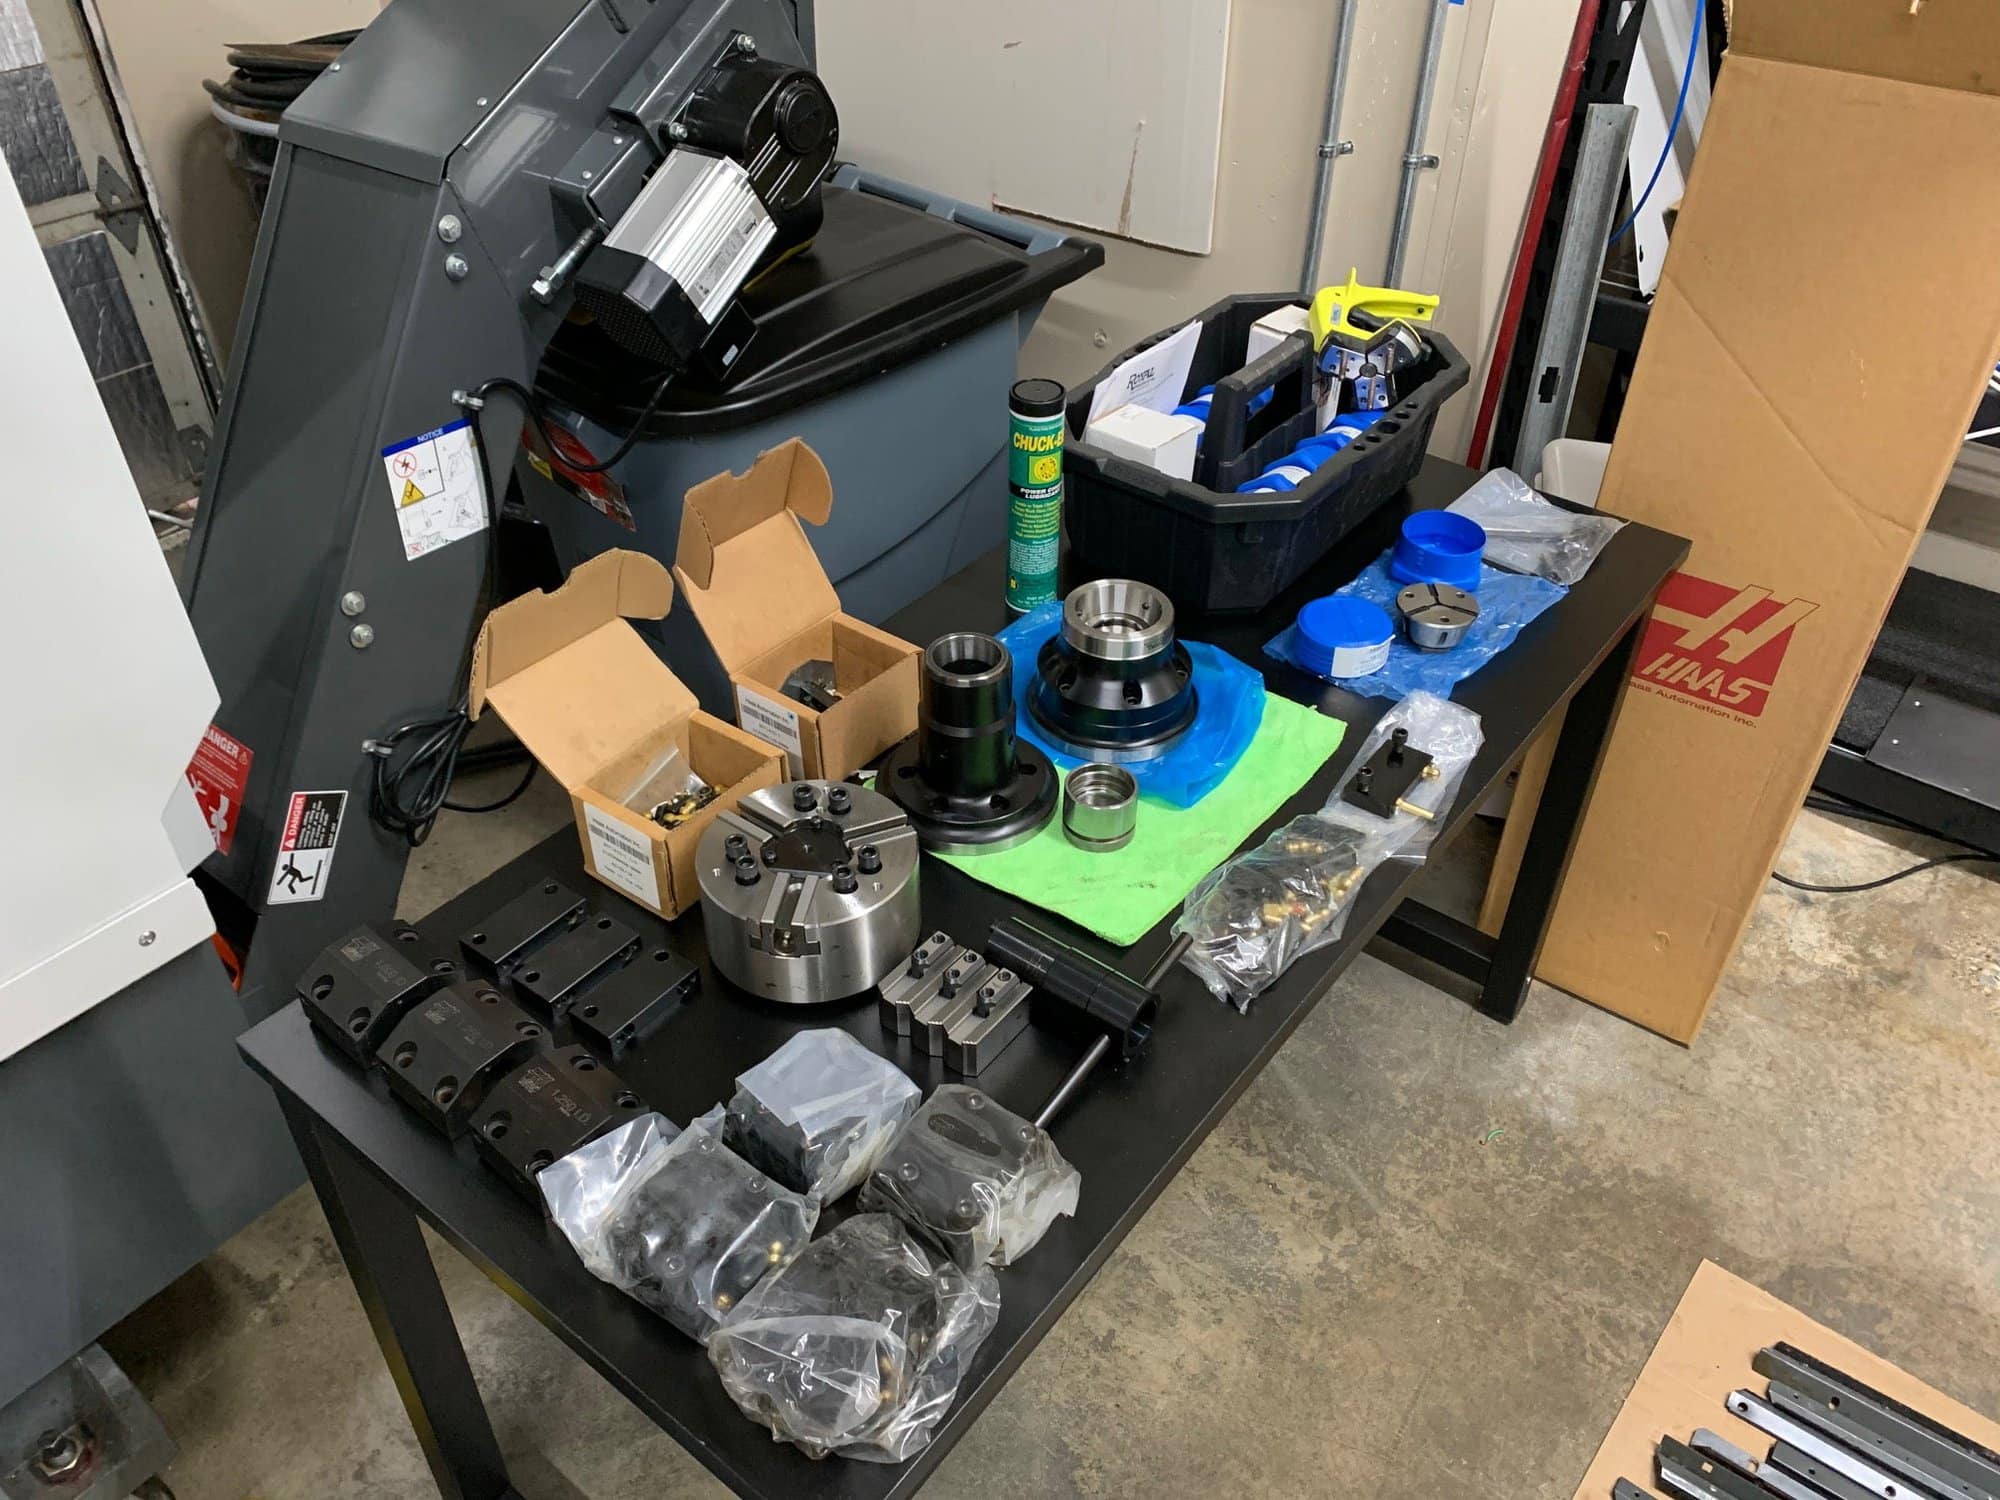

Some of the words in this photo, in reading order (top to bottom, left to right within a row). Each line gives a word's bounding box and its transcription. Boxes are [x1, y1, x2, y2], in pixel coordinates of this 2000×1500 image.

[417, 428, 444, 442] NOTICE
[1641, 652, 1771, 705] HAAS
[1628, 680, 1652, 693] aas
[1655, 688, 1730, 719] Automation
[1733, 714, 1757, 728] Inc.
[288, 796, 305, 837] DANGER
